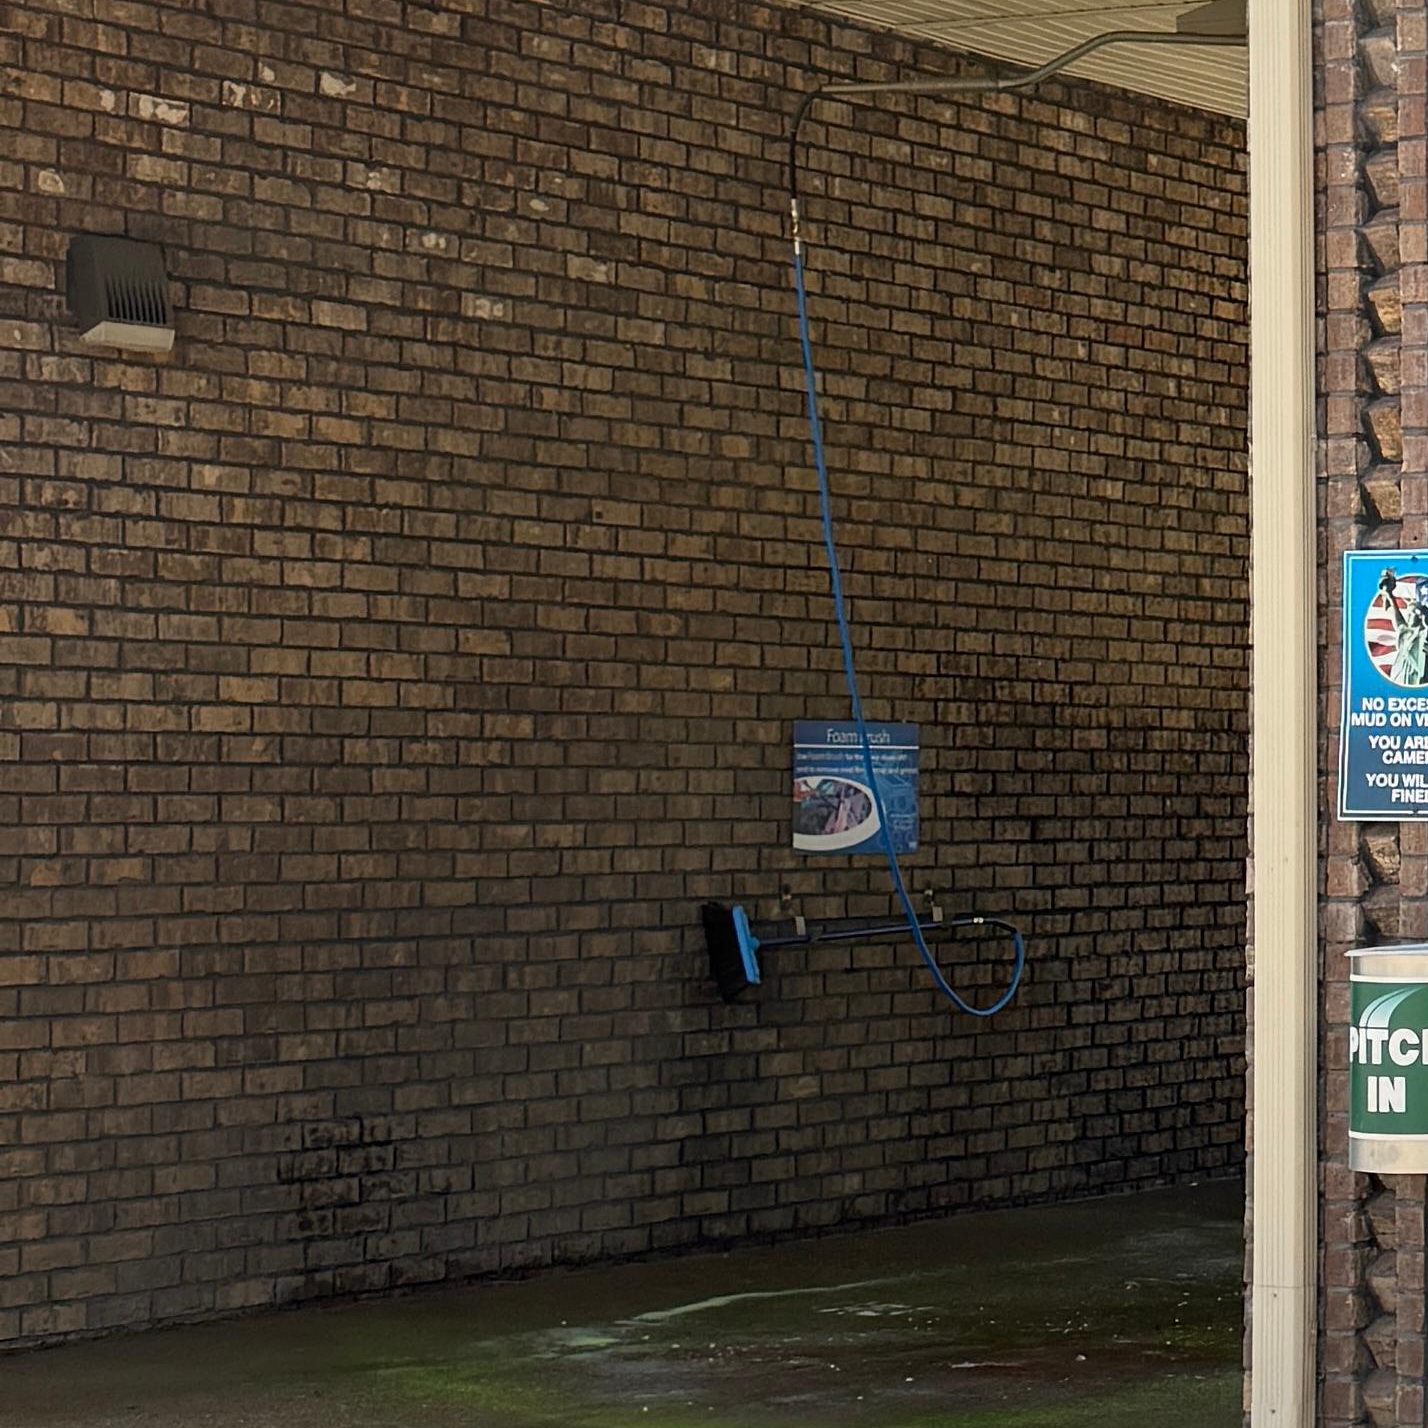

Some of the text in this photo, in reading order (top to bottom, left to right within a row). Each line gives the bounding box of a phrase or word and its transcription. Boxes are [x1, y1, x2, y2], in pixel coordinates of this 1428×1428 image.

[1362, 697, 1384, 712] NO
[1351, 712, 1386, 727] MUD
[1390, 713, 1412, 727] ON
[826, 728, 890, 744] Foam rush
[1368, 736, 1401, 750] YOU
[1365, 773, 1399, 788] YOU
[1367, 1076, 1406, 1113] IN
